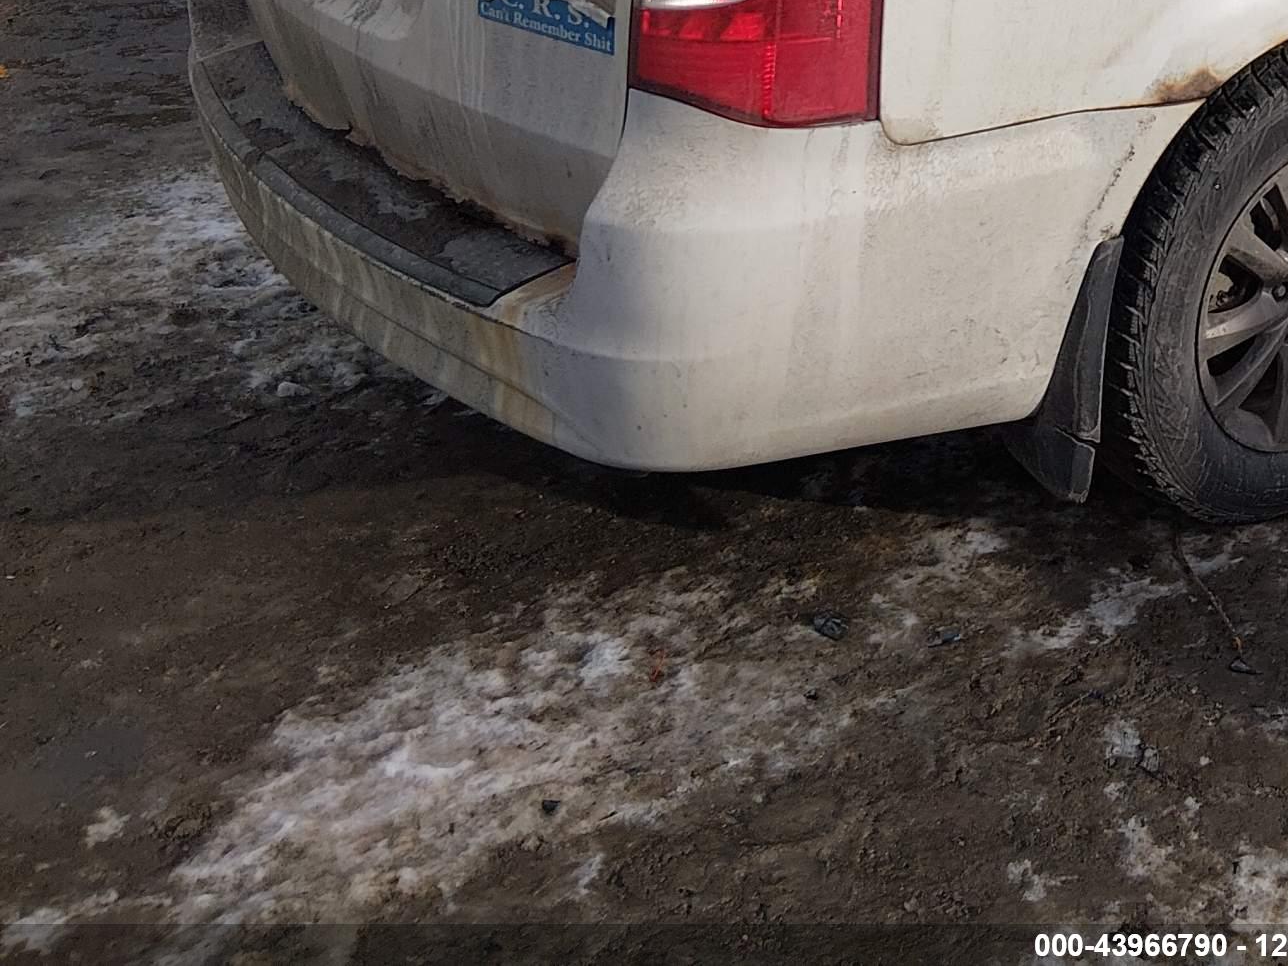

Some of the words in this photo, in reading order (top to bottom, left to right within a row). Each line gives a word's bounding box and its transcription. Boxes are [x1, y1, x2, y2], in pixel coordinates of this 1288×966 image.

[480, 1, 510, 22] Can't
[513, 11, 581, 43] Remember
[584, 31, 612, 53] Shit
